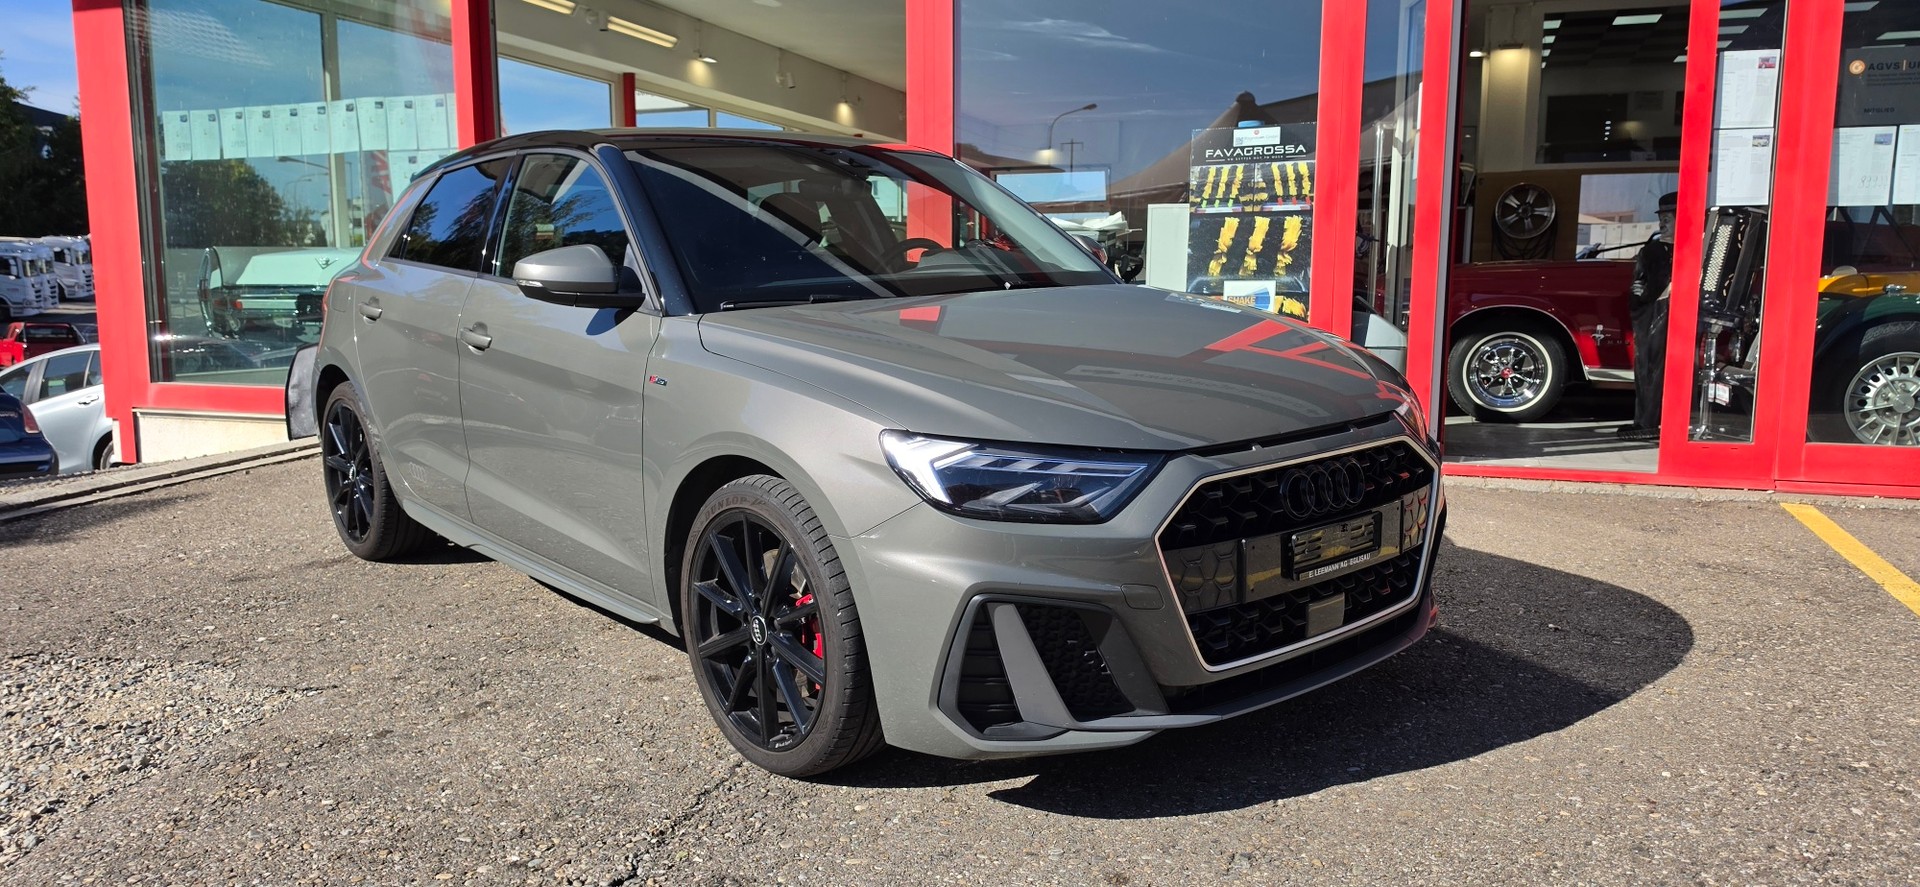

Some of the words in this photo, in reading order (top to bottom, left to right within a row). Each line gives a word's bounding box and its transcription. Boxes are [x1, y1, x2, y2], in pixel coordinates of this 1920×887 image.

[1867, 61, 1901, 71] AGVS
[1205, 144, 1307, 158] FAVAGROSSA
[705, 496, 750, 519] DUNLOP
[1315, 563, 1340, 577] LEEMANN
